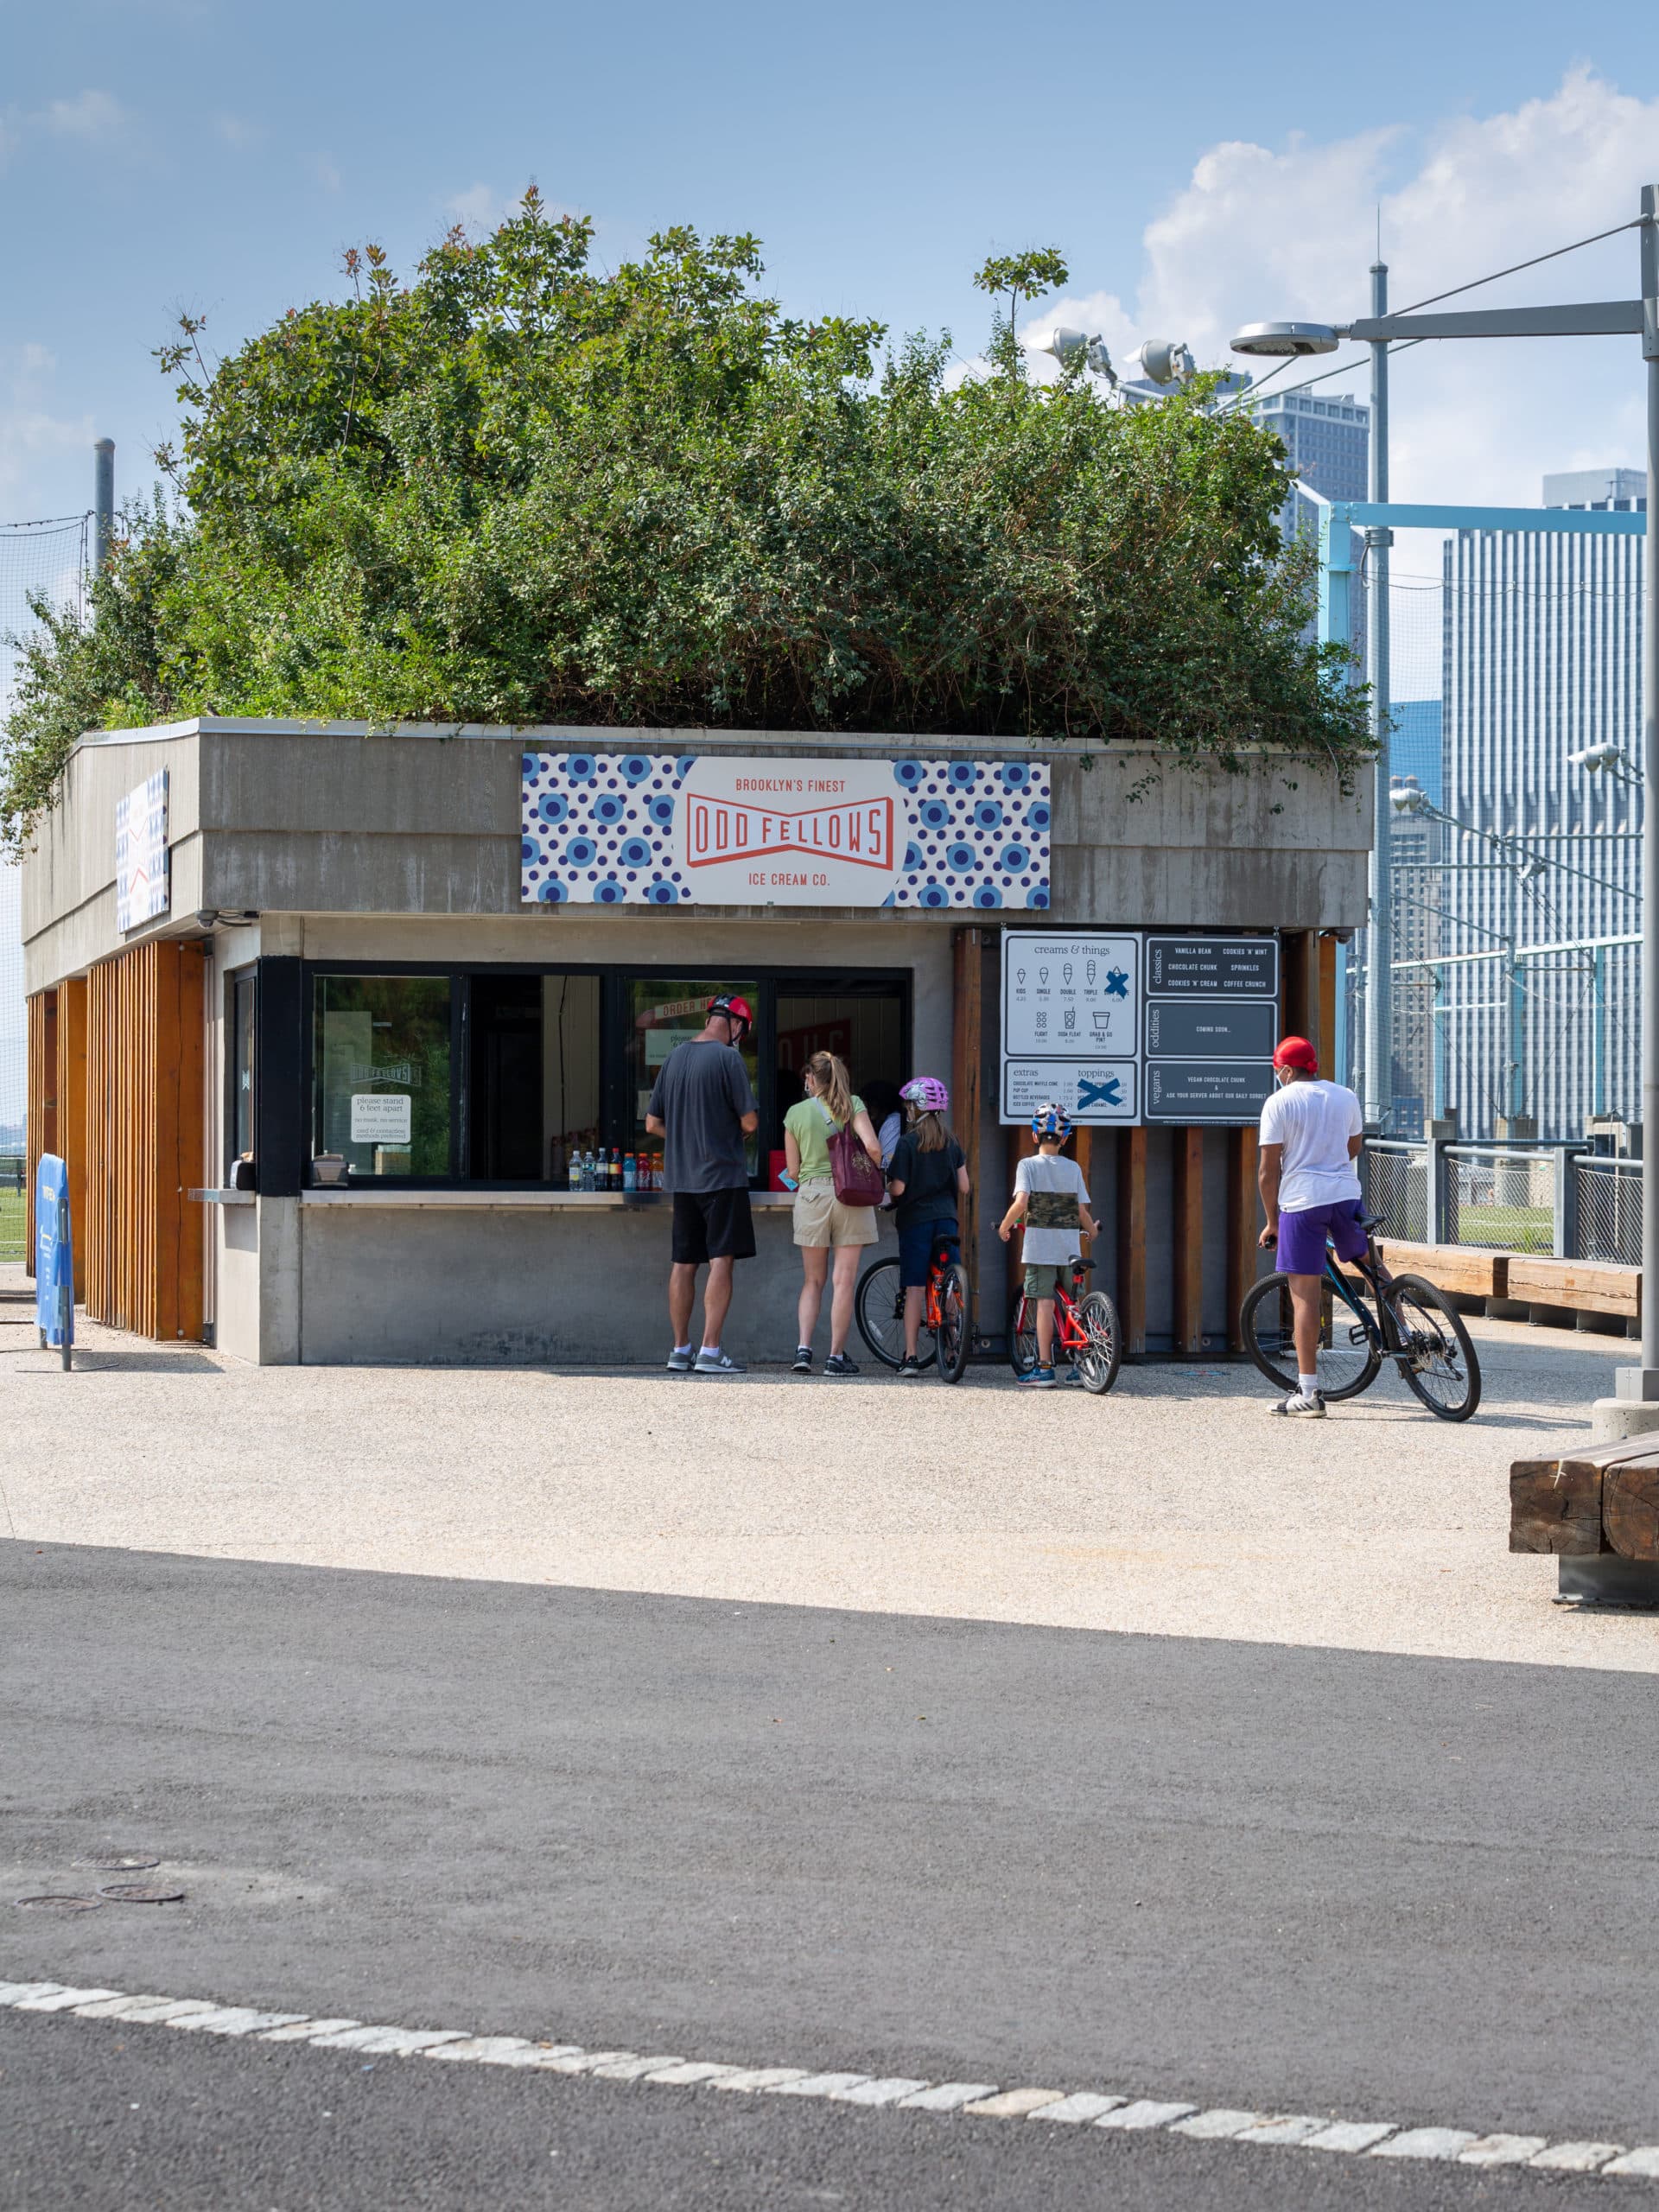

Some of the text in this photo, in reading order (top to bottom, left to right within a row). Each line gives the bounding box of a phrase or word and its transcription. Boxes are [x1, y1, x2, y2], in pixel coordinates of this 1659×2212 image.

[735, 779, 845, 792] BROOKLYN'S FINEST
[696, 805, 881, 855] ODD FELLOWS
[748, 873, 830, 886] ICE CREAM CO.
[1034, 945, 1110, 957] creams & things
[1153, 948, 1162, 984] classics
[663, 1001, 695, 1017] ORDER
[1150, 1009, 1160, 1048] oddities
[1078, 1070, 1114, 1078] toppings
[1153, 1070, 1162, 1104] vegans
[357, 1096, 381, 1105] please
